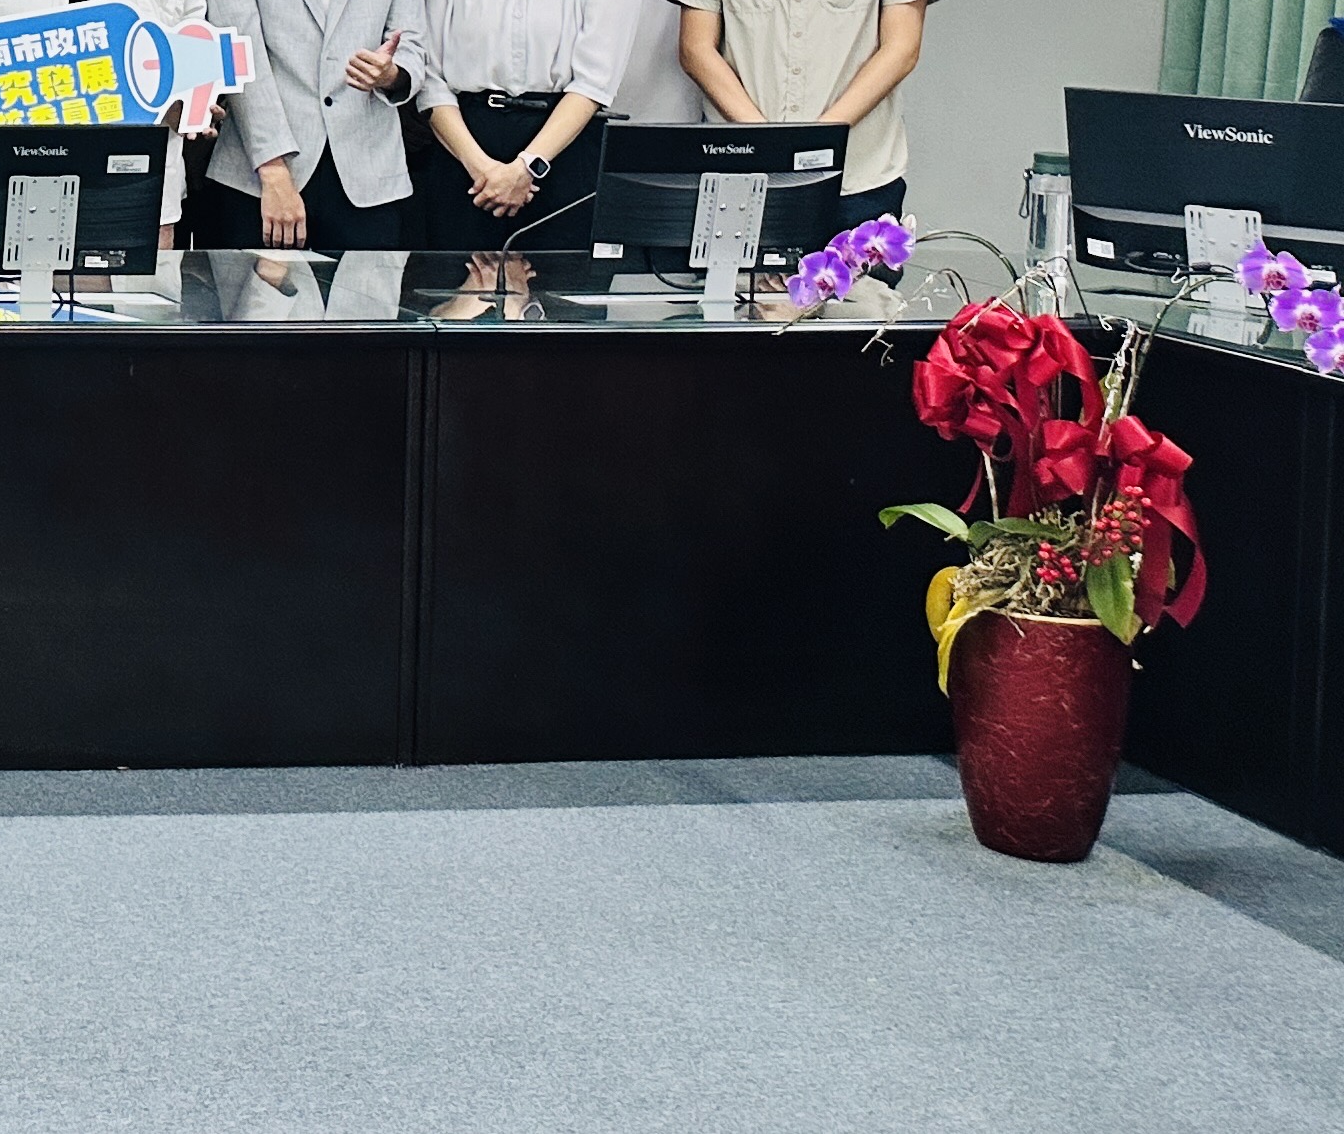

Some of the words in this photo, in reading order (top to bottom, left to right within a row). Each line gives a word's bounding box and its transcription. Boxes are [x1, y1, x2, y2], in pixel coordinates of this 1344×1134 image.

[1183, 123, 1275, 145] ViewSonic
[12, 145, 69, 157] ViewSonic
[702, 143, 755, 155] ViewSonic
